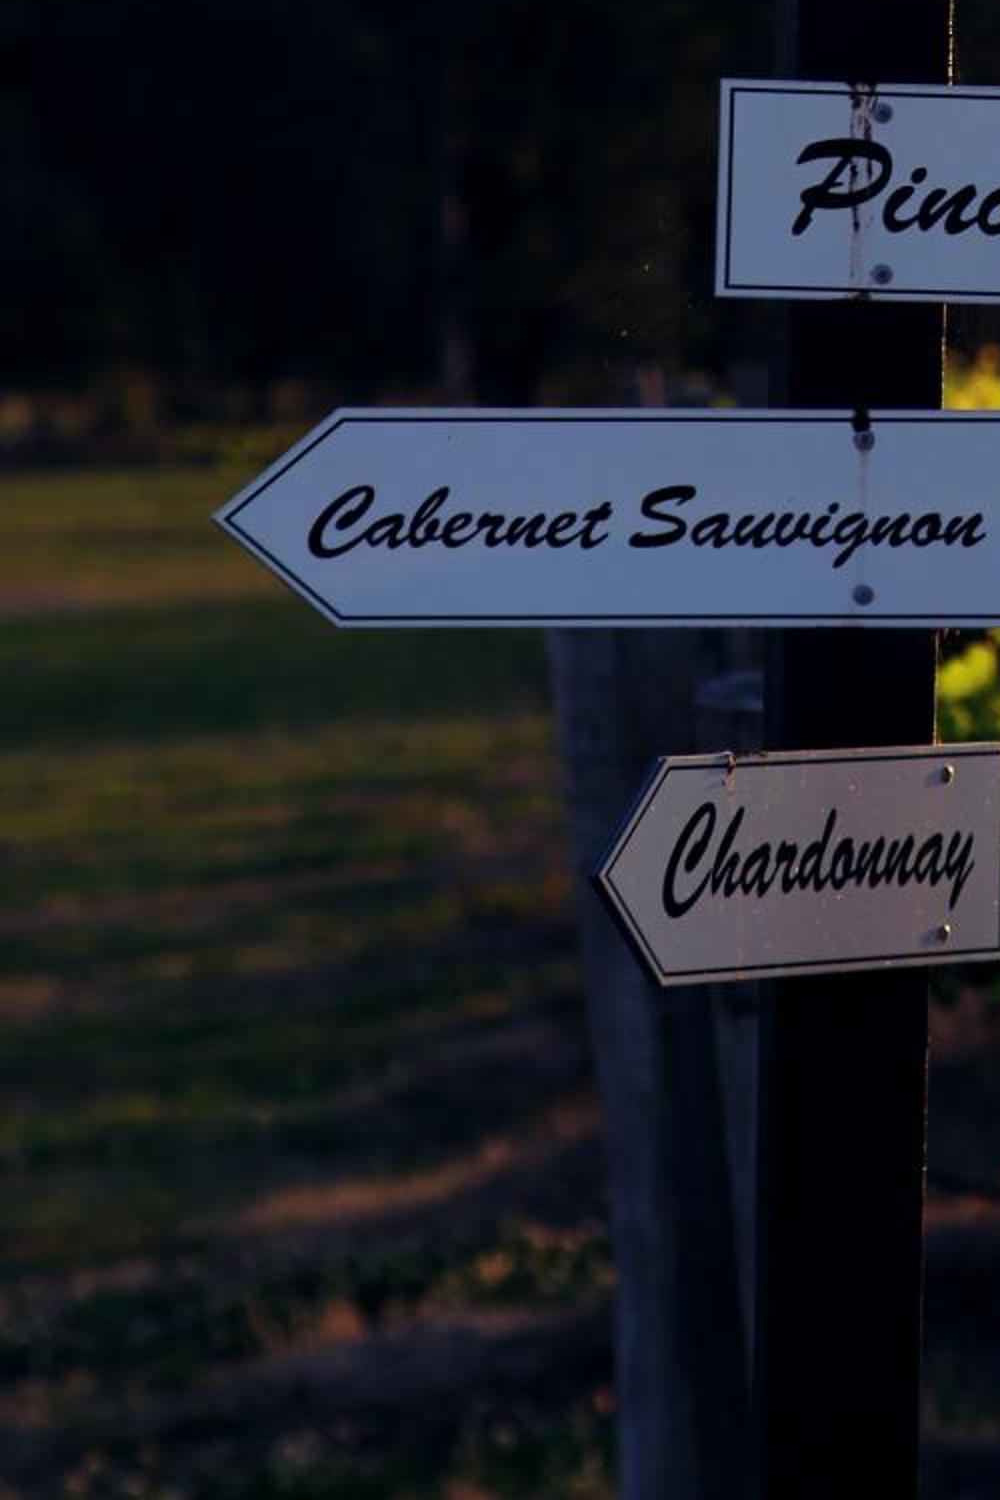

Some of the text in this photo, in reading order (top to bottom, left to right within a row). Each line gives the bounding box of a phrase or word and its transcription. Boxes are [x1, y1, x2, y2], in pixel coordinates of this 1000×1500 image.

[308, 485, 987, 569] Cabernet Sauvignon
[663, 801, 975, 919] Chardonnay
